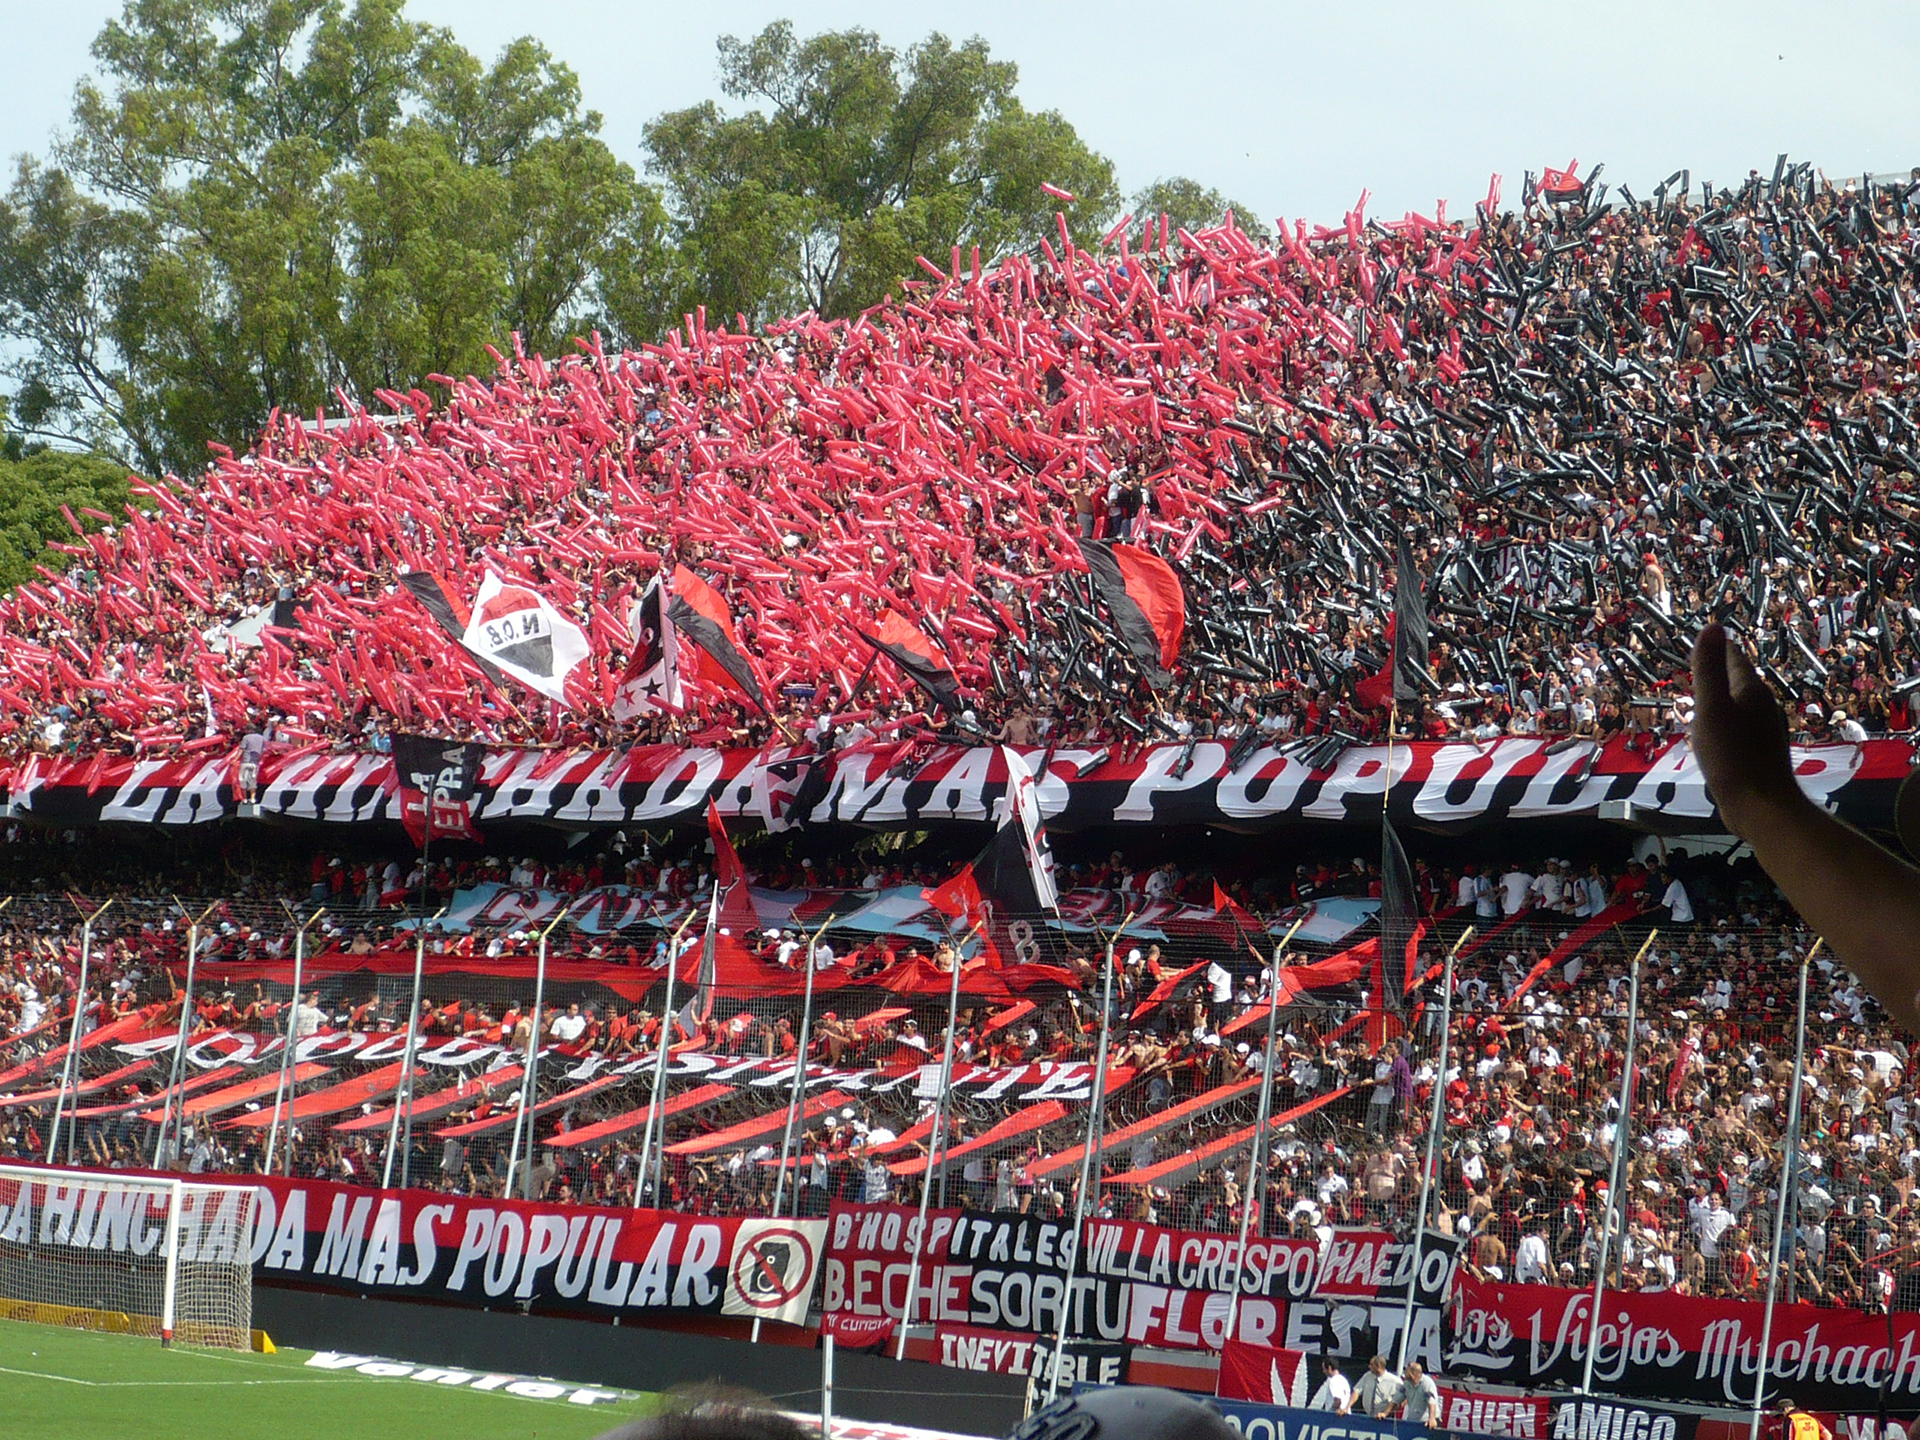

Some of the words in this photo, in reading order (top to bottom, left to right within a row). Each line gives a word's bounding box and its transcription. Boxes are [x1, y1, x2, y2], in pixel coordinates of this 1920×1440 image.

[100, 758, 229, 824] LA
[39, 1180, 307, 1270] HINCHADA
[313, 1192, 455, 1287] MAS
[446, 1208, 722, 1308] POPULAR
[1086, 1222, 1172, 1285] VILLA
[1177, 1238, 1316, 1297] CRESPO
[1322, 1242, 1450, 1294] HAEDO
[940, 1333, 1121, 1390] INEVITABLE
[1126, 1282, 1443, 1374] FLORESTA
[1444, 1282, 1514, 1369] Los
[1528, 1294, 1686, 1382] Viejos
[1447, 1397, 1536, 1438] BUEN
[1552, 1402, 1677, 1440] AMIGO
